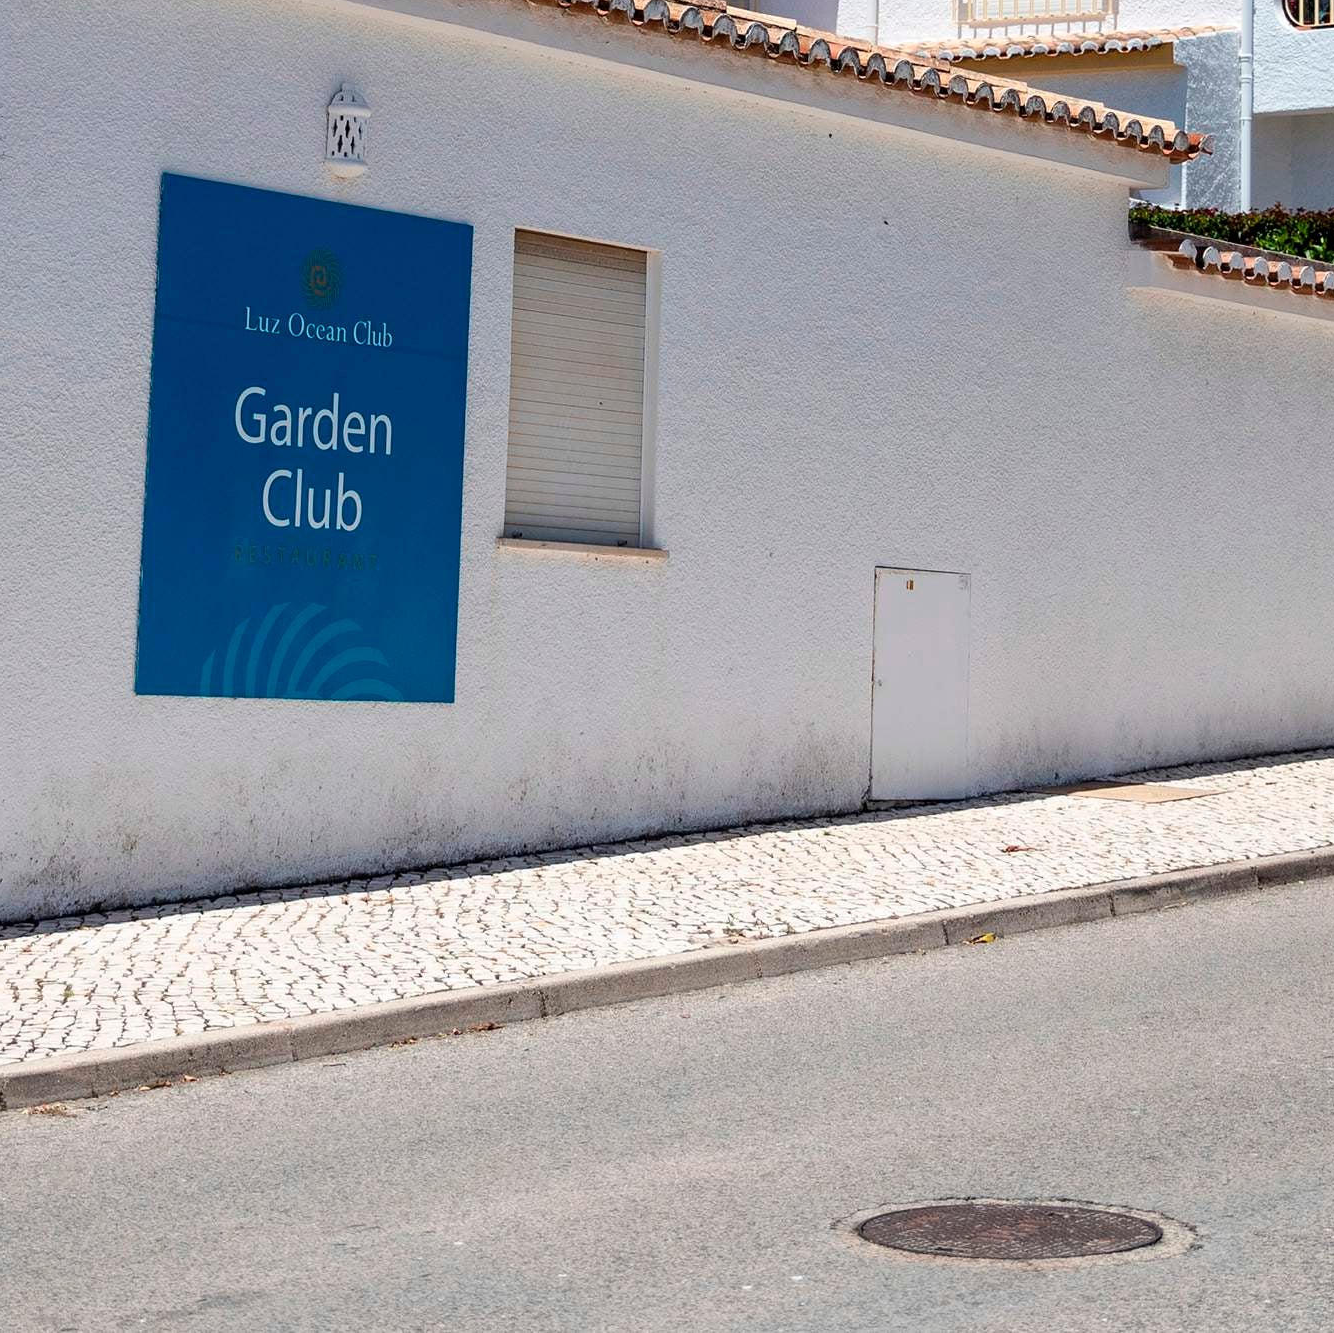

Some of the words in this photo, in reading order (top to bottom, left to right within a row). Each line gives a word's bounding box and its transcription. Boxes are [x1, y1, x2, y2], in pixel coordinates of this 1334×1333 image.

[245, 306, 280, 334] Luz
[288, 312, 347, 343] Ocean
[353, 320, 393, 348] Club
[234, 386, 393, 454] Garden
[262, 468, 363, 532] Club
